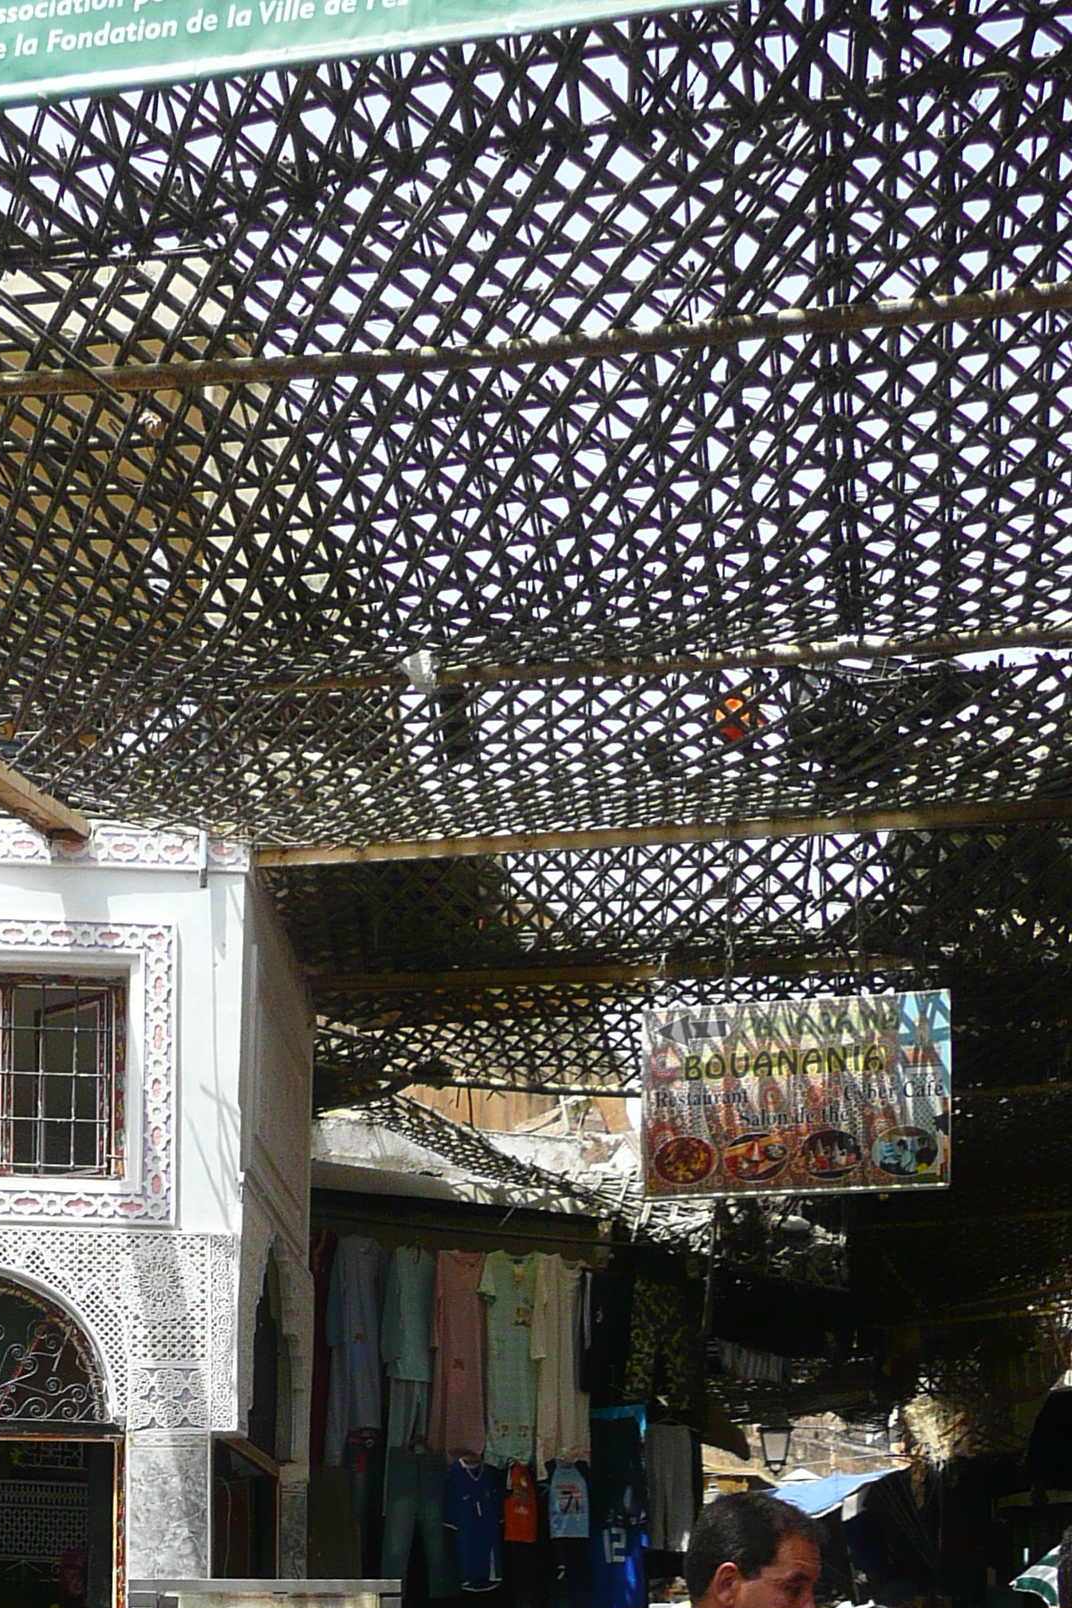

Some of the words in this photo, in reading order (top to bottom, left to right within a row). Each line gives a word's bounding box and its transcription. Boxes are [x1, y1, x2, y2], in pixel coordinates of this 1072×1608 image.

[14, 33, 38, 57] la
[46, 18, 178, 53] Fondation
[186, 9, 218, 33] de
[226, 5, 252, 28] la
[259, 0, 315, 24] Ville
[324, 0, 357, 16] de
[684, 1043, 885, 1081] BOUANANIA
[655, 1089, 748, 1108] Restaurant
[844, 1083, 895, 1102] Cyber
[903, 1077, 944, 1099] Café
[739, 1108, 788, 1127] Salon
[795, 1107, 815, 1124] de
